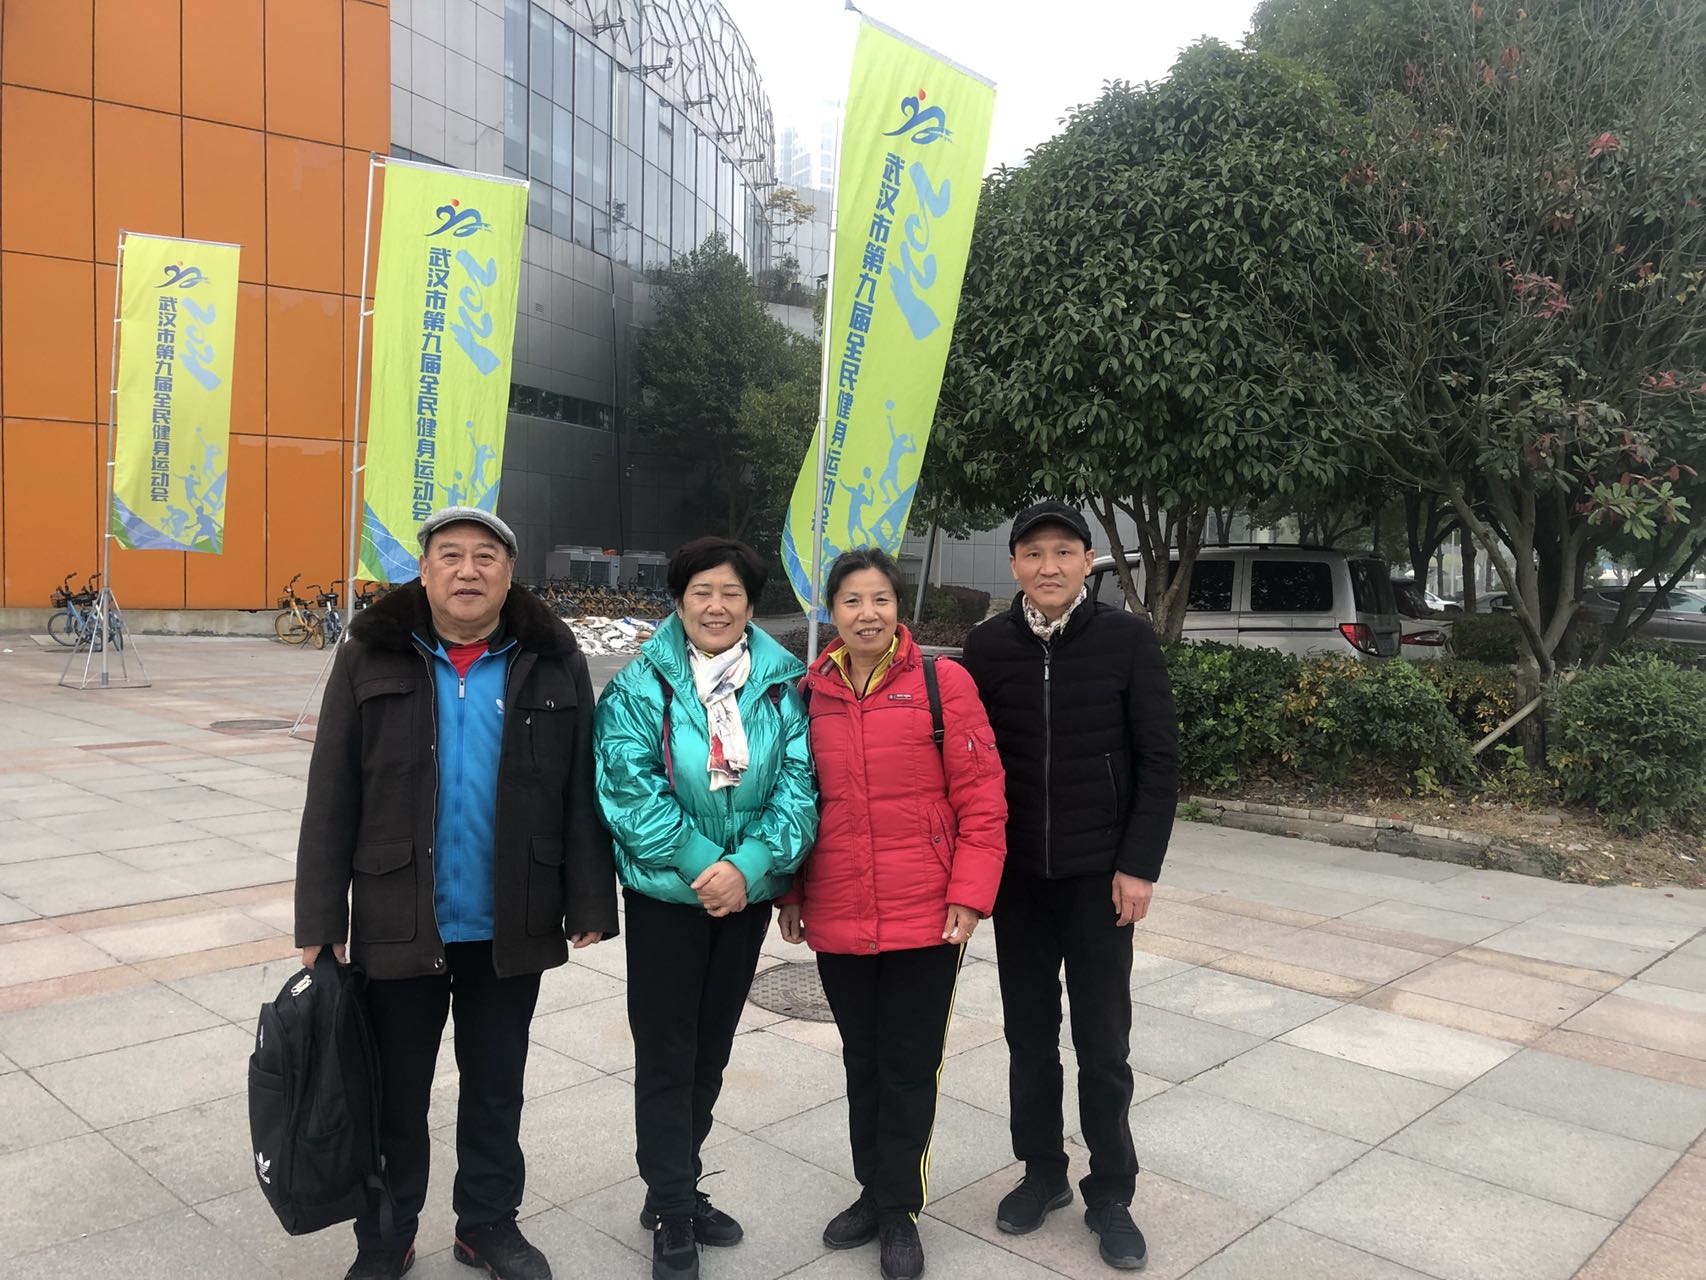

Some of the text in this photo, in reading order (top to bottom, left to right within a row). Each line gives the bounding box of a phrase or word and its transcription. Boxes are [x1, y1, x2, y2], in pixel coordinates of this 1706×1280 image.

[150, 296, 177, 502] 武汉市第九届全民健身运动会
[411, 247, 451, 521] 武汉市第九届全民健身运动会
